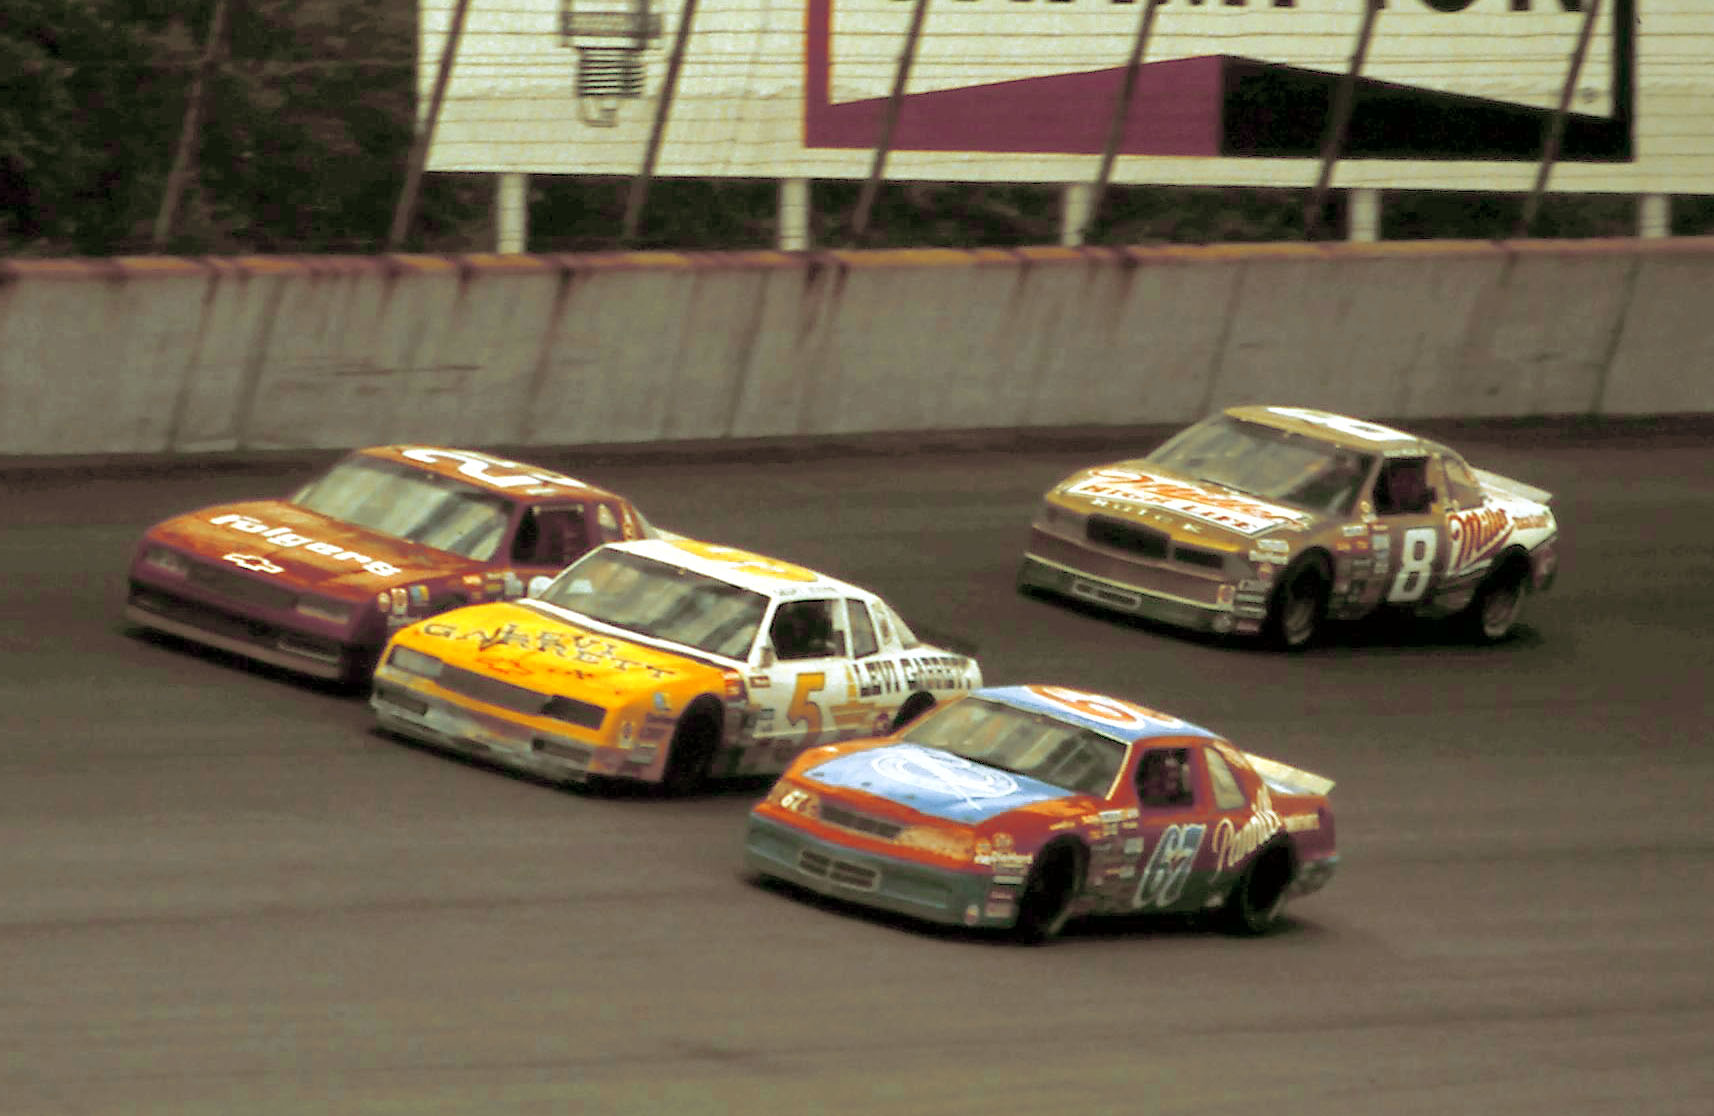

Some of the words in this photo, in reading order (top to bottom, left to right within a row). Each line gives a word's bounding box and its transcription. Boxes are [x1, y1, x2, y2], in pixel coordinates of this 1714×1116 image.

[1387, 528, 1437, 602] 8
[786, 672, 825, 748] 5
[853, 660, 900, 697] LEVI
[1132, 823, 1207, 907] 67
